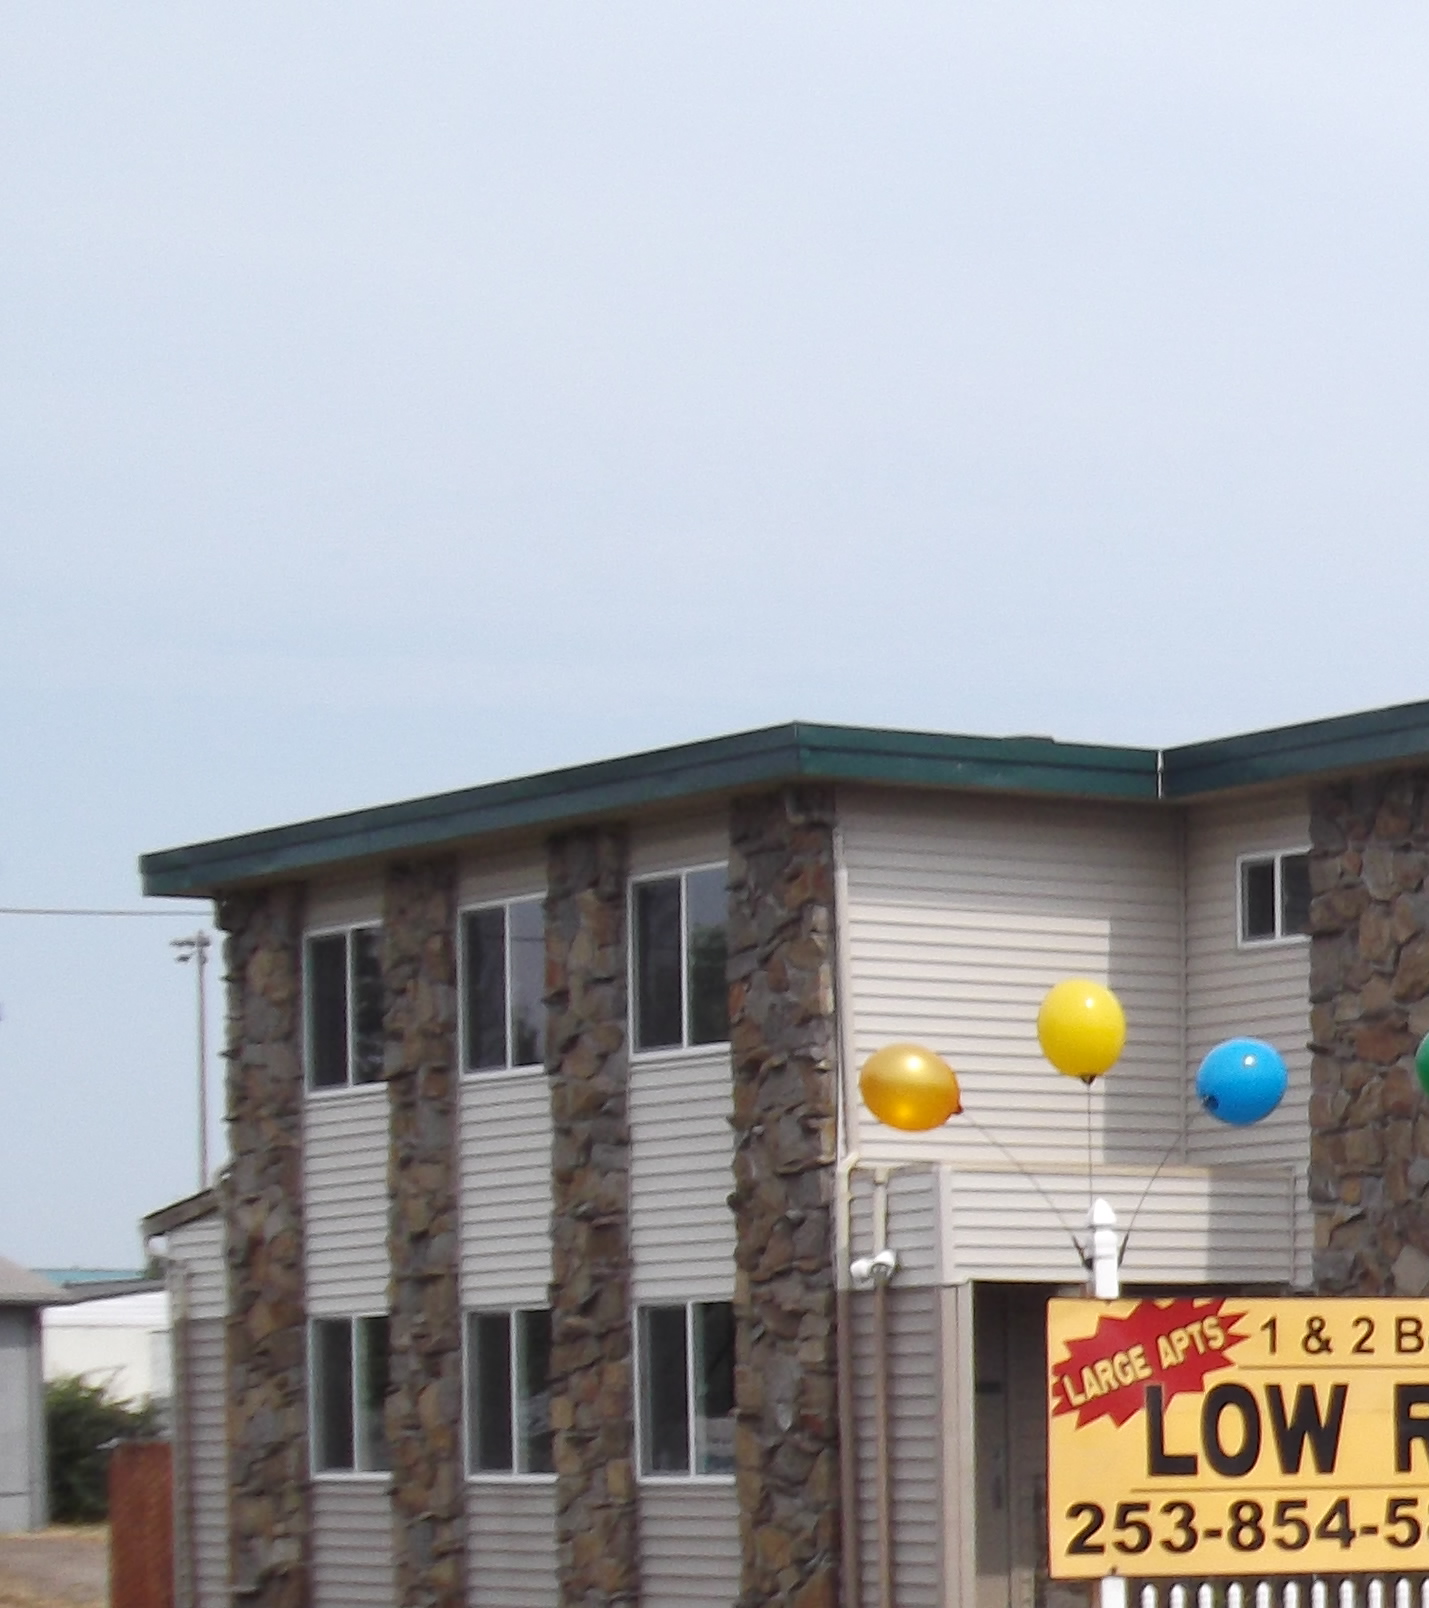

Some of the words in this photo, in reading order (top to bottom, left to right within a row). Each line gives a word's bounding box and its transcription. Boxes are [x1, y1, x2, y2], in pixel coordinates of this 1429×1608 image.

[1062, 1344, 1153, 1406] LARGE
[1156, 1315, 1225, 1370] APTS
[1259, 1316, 1278, 1356] 1
[1302, 1316, 1333, 1356] &
[1351, 1316, 1376, 1355] 2
[1144, 1382, 1349, 1477] LOW
